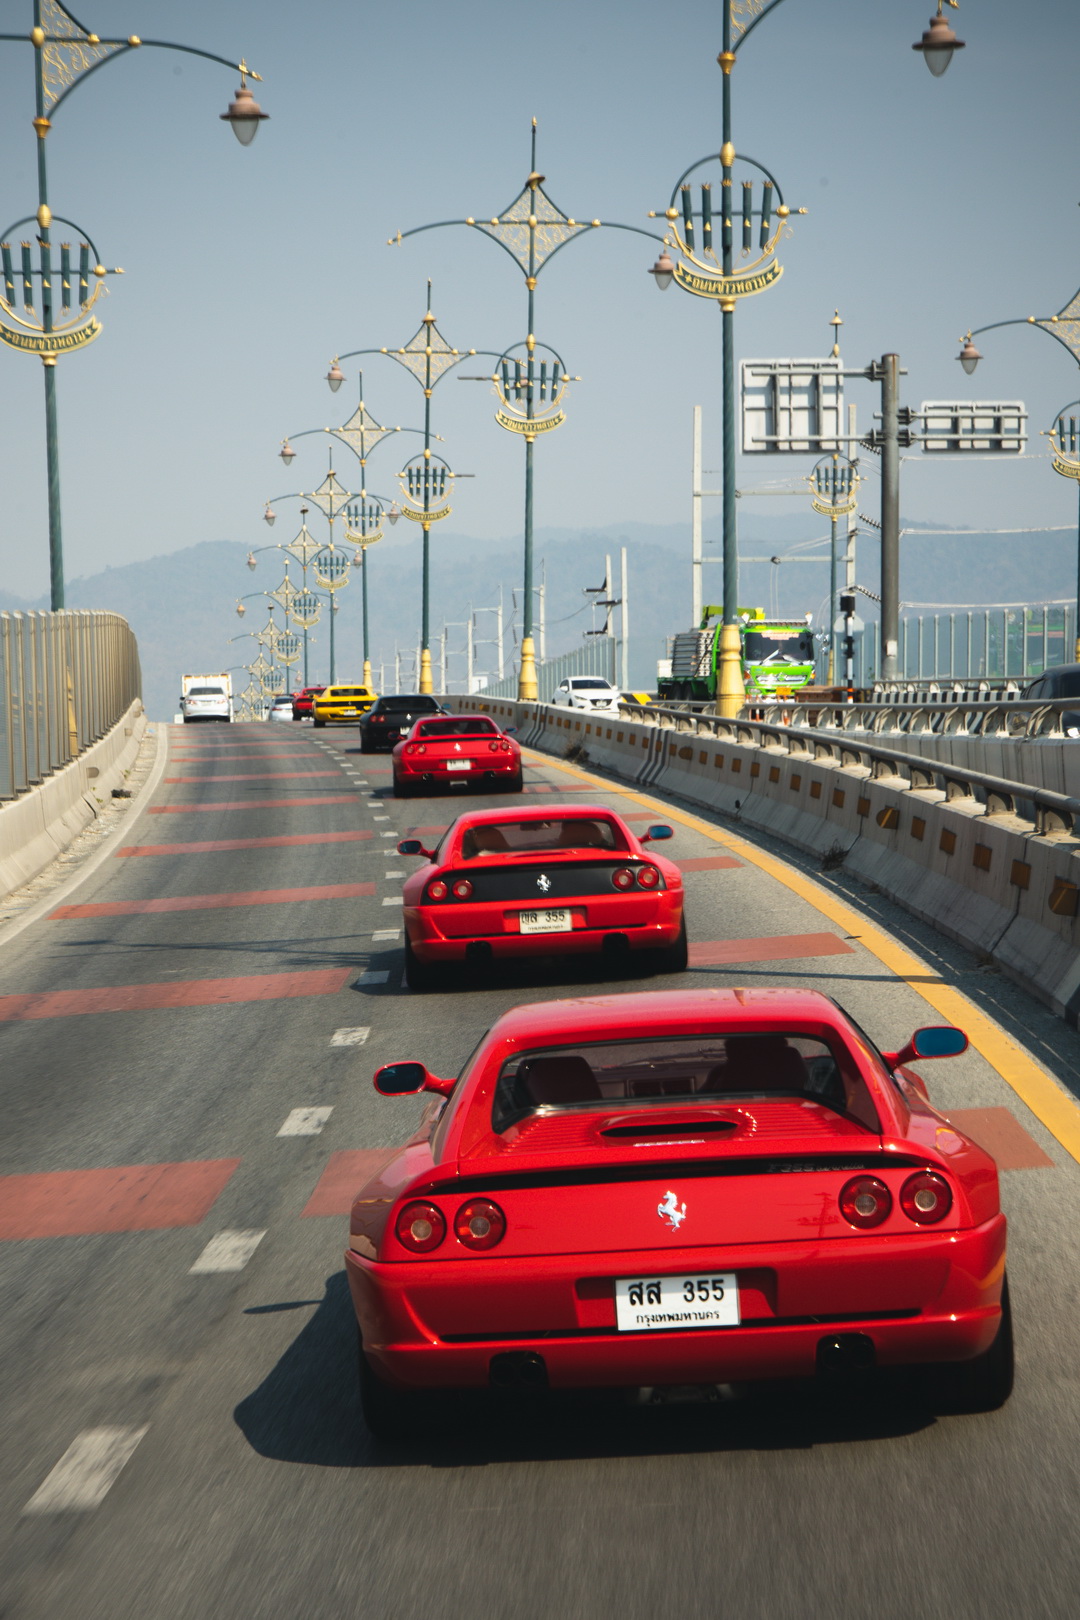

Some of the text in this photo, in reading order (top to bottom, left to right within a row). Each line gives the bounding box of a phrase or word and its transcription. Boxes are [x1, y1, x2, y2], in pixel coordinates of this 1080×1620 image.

[545, 910, 565, 923] 355
[628, 1278, 725, 1306] สส 355
[636, 1310, 720, 1327] กรุงเทพมหานคร
